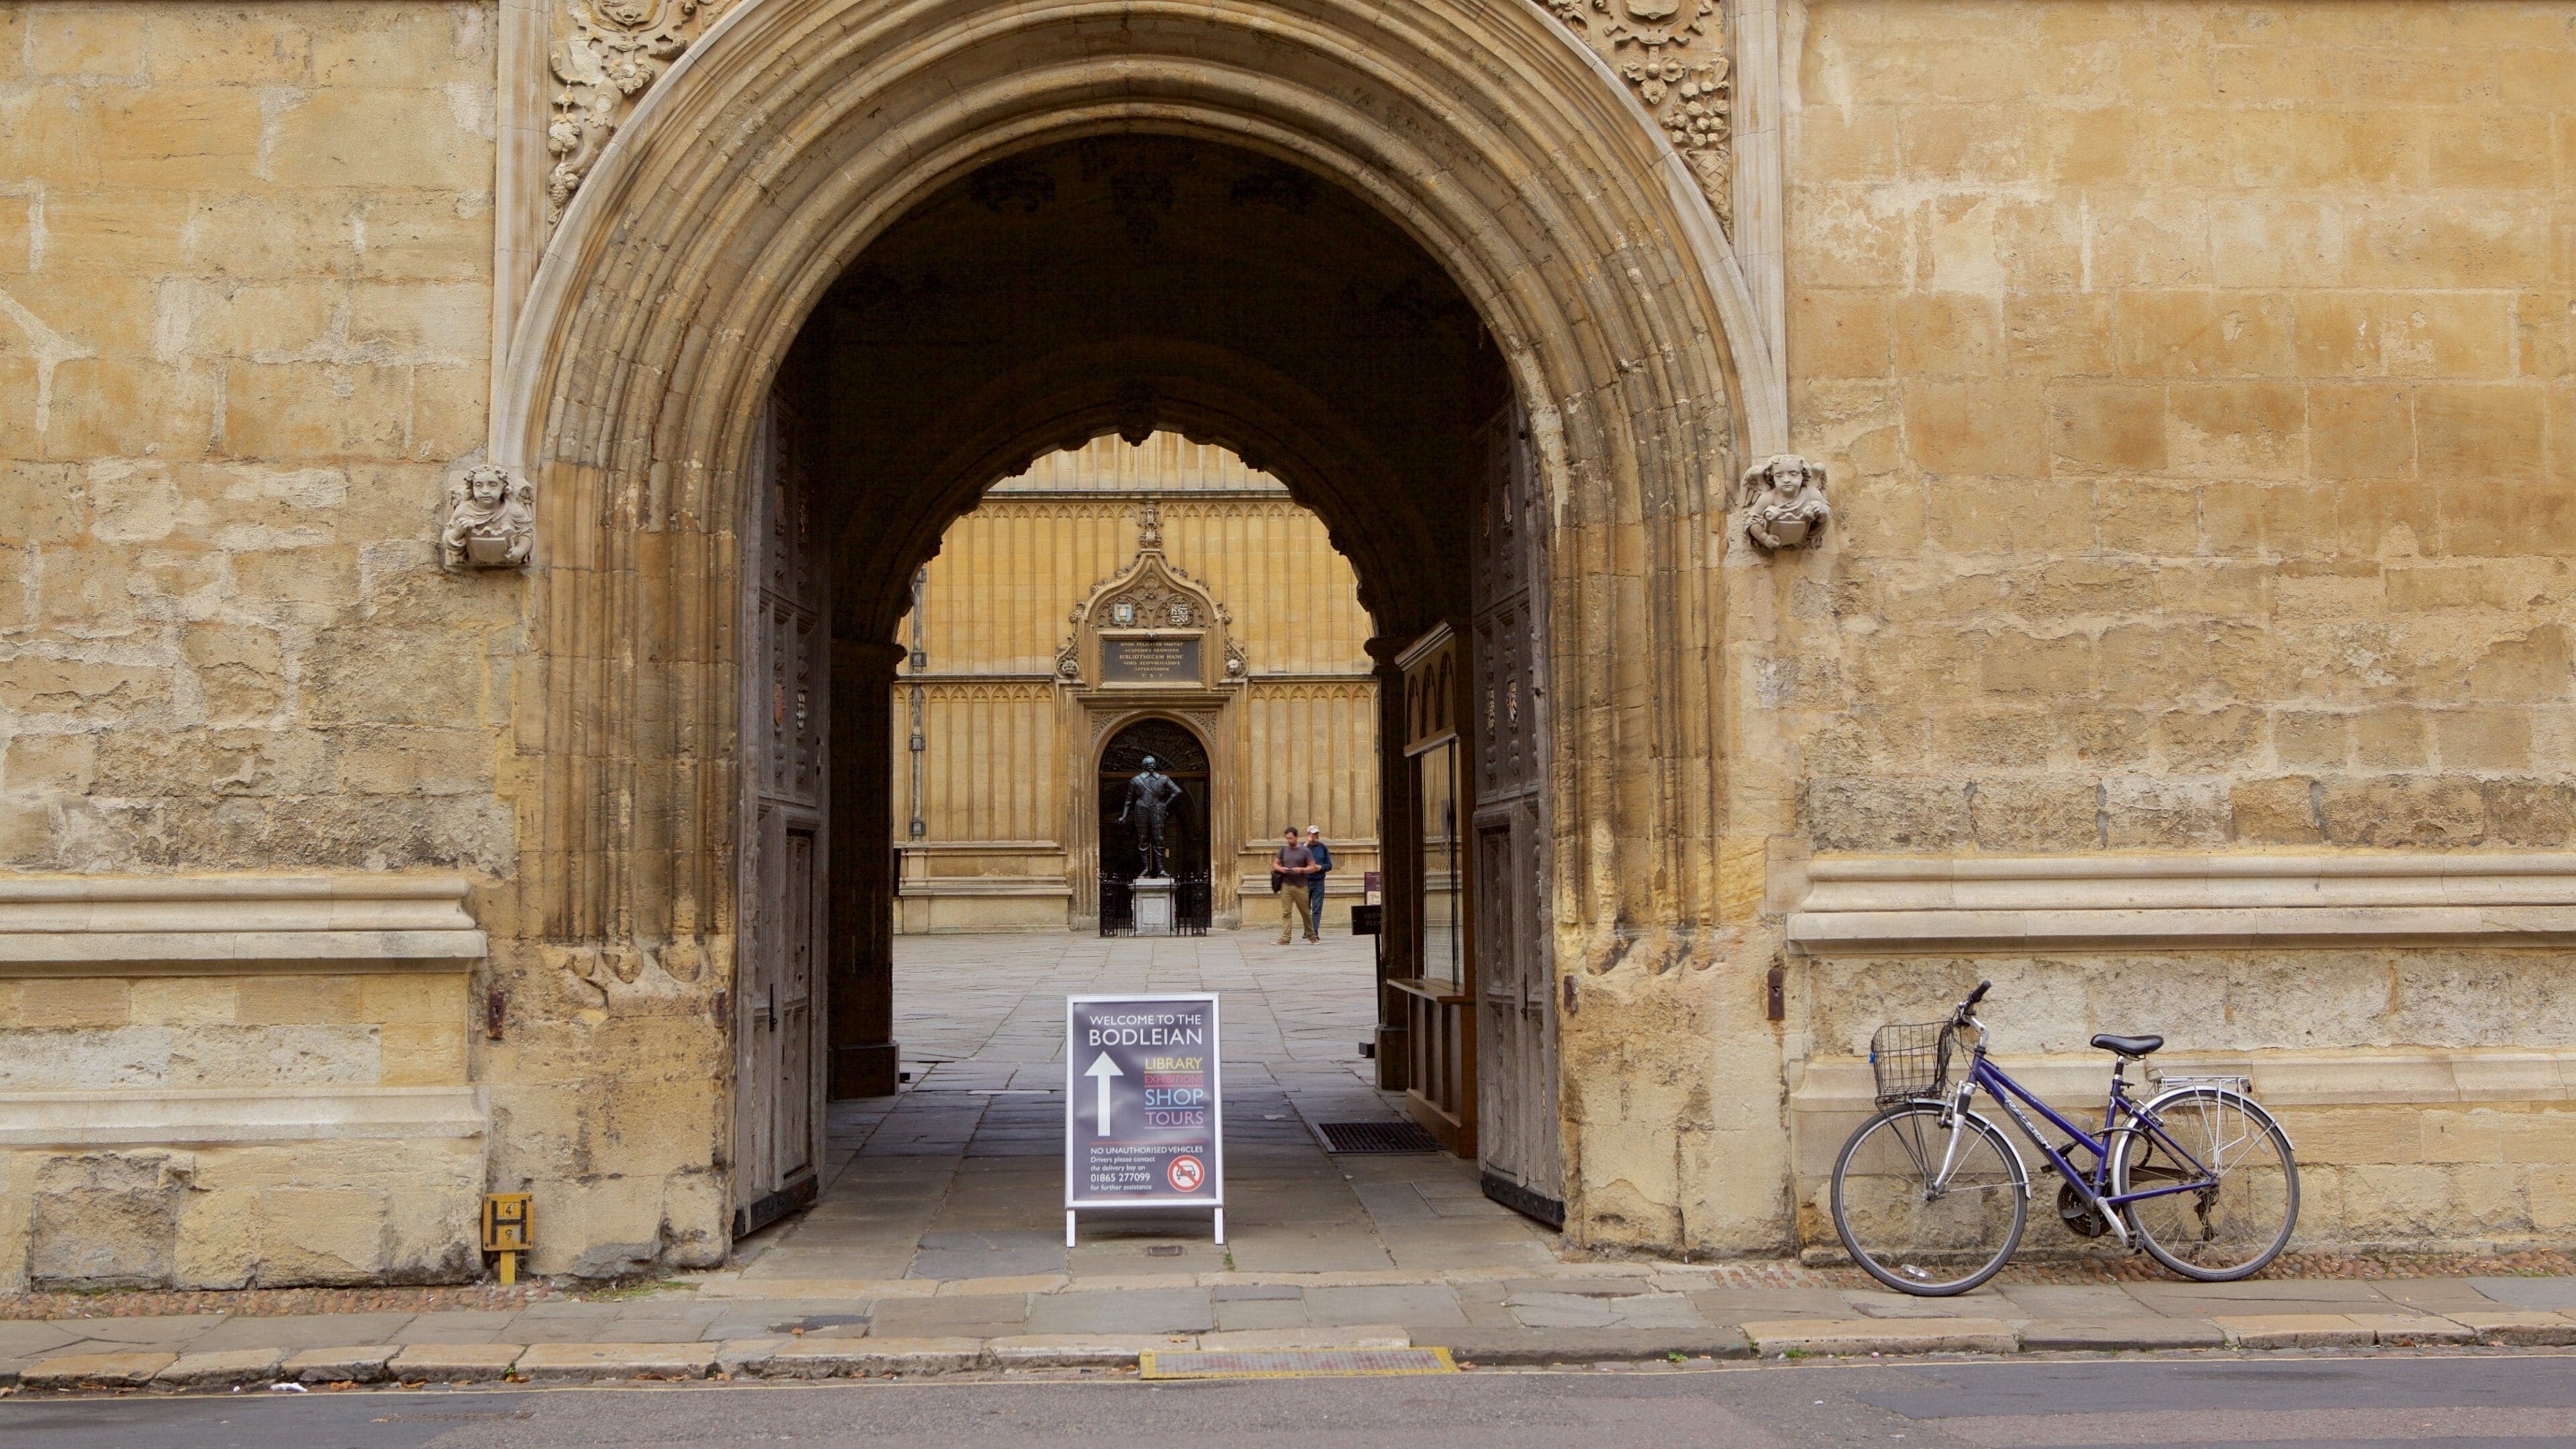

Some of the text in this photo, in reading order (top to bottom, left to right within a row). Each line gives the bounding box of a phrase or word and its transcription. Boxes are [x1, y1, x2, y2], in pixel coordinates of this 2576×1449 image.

[1089, 1014, 1202, 1026] WELCOME TO THE
[1089, 1028, 1202, 1046] BODLEIAN
[1144, 1057, 1203, 1070] LIBRARY
[1144, 1075, 1203, 1084] EXHIBITIONS
[1144, 1088, 1203, 1106] SHOP
[1144, 1111, 1203, 1126] TOURS
[1106, 1146, 1167, 1155] UNAUTHORISED
[1169, 1146, 1203, 1154] VEHICLES
[1102, 1165, 1125, 1173] delivery
[1091, 1173, 1150, 1183] 01865 277099
[491, 1199, 527, 1246] H
